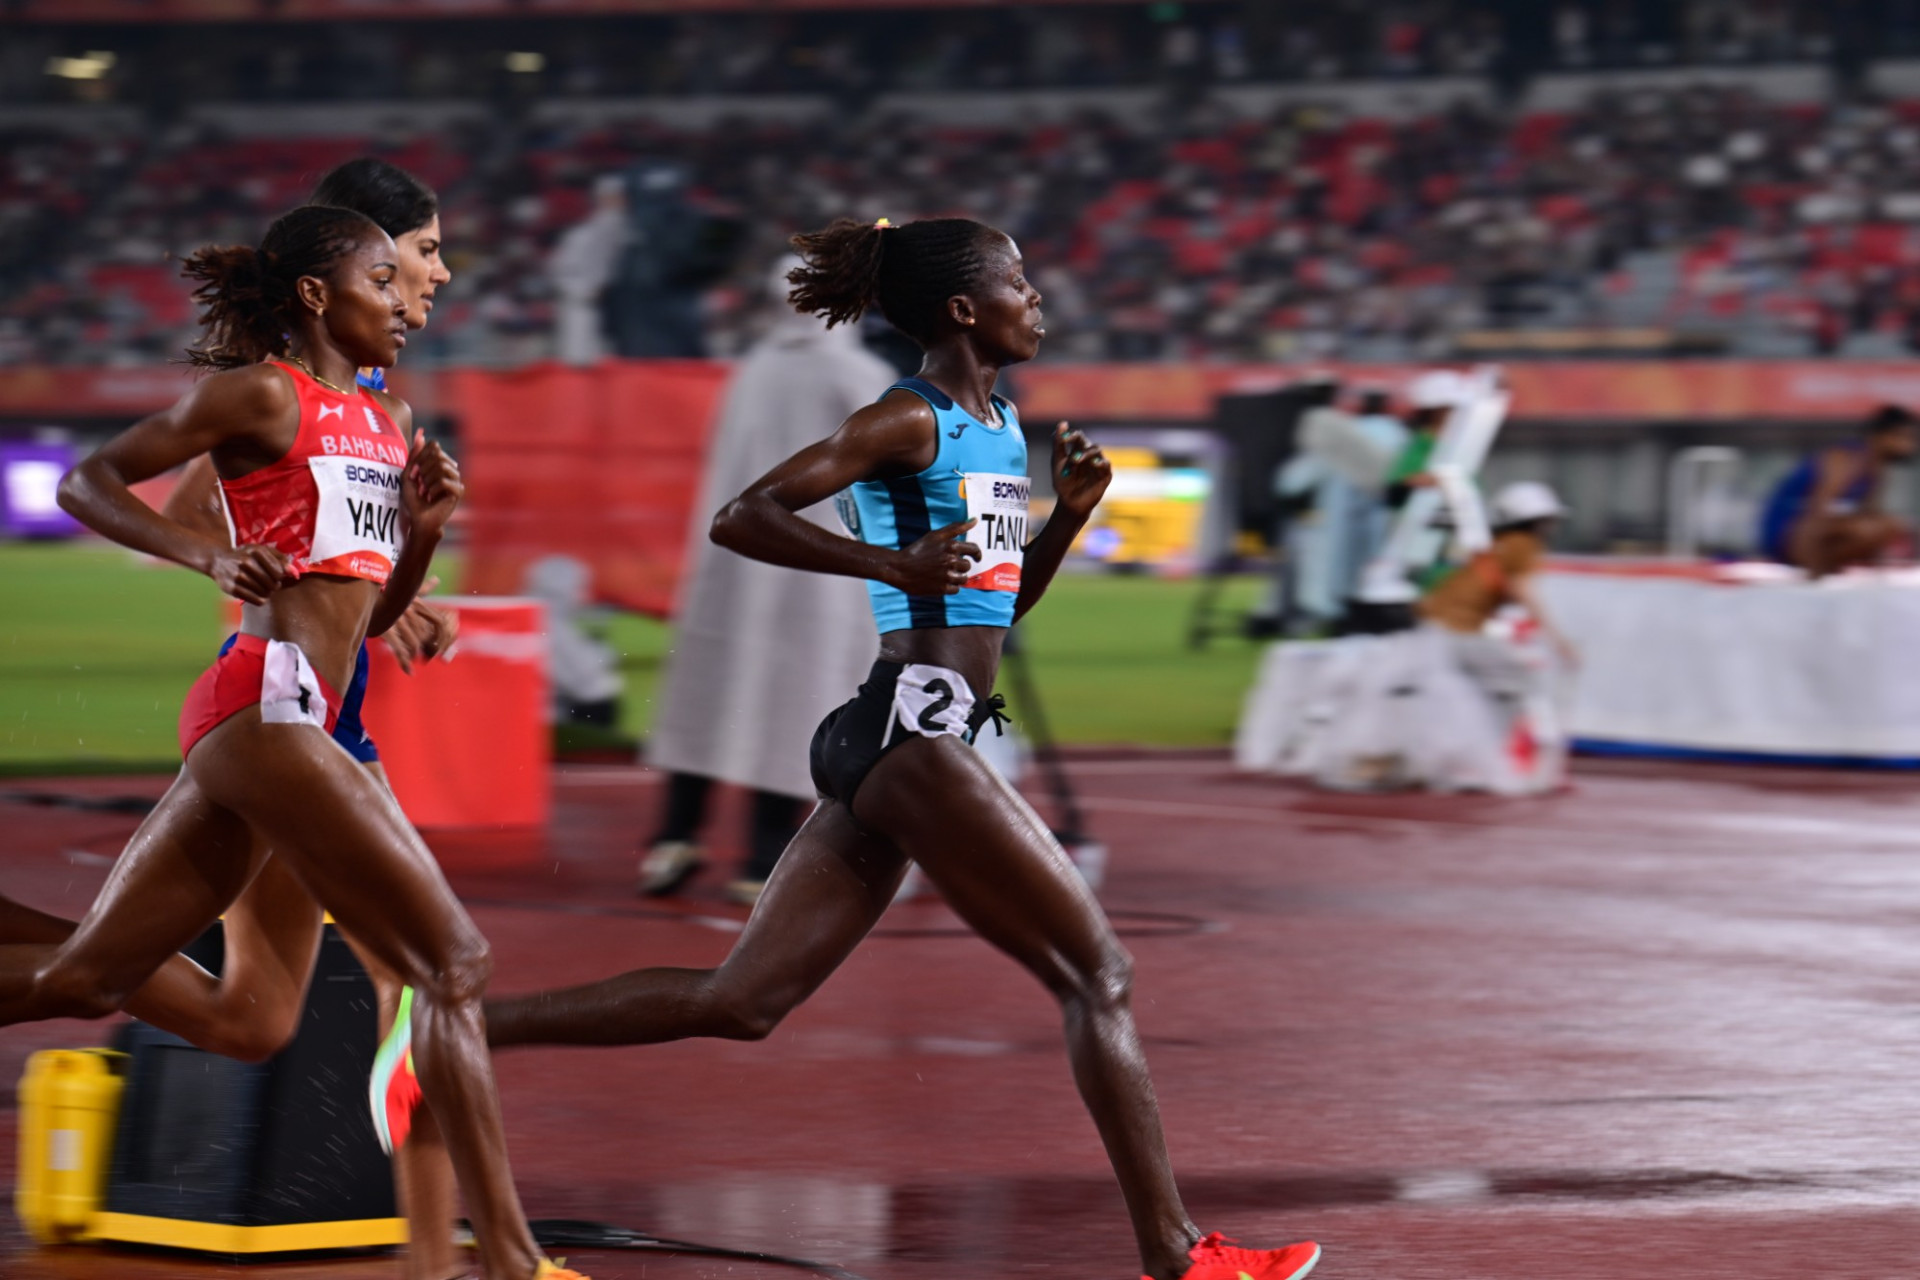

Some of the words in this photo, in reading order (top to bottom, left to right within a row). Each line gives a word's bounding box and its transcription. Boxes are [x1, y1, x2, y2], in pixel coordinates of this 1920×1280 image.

[321, 435, 406, 467] BAHRAIN
[346, 498, 399, 545] YAVI
[917, 677, 954, 731] 2
